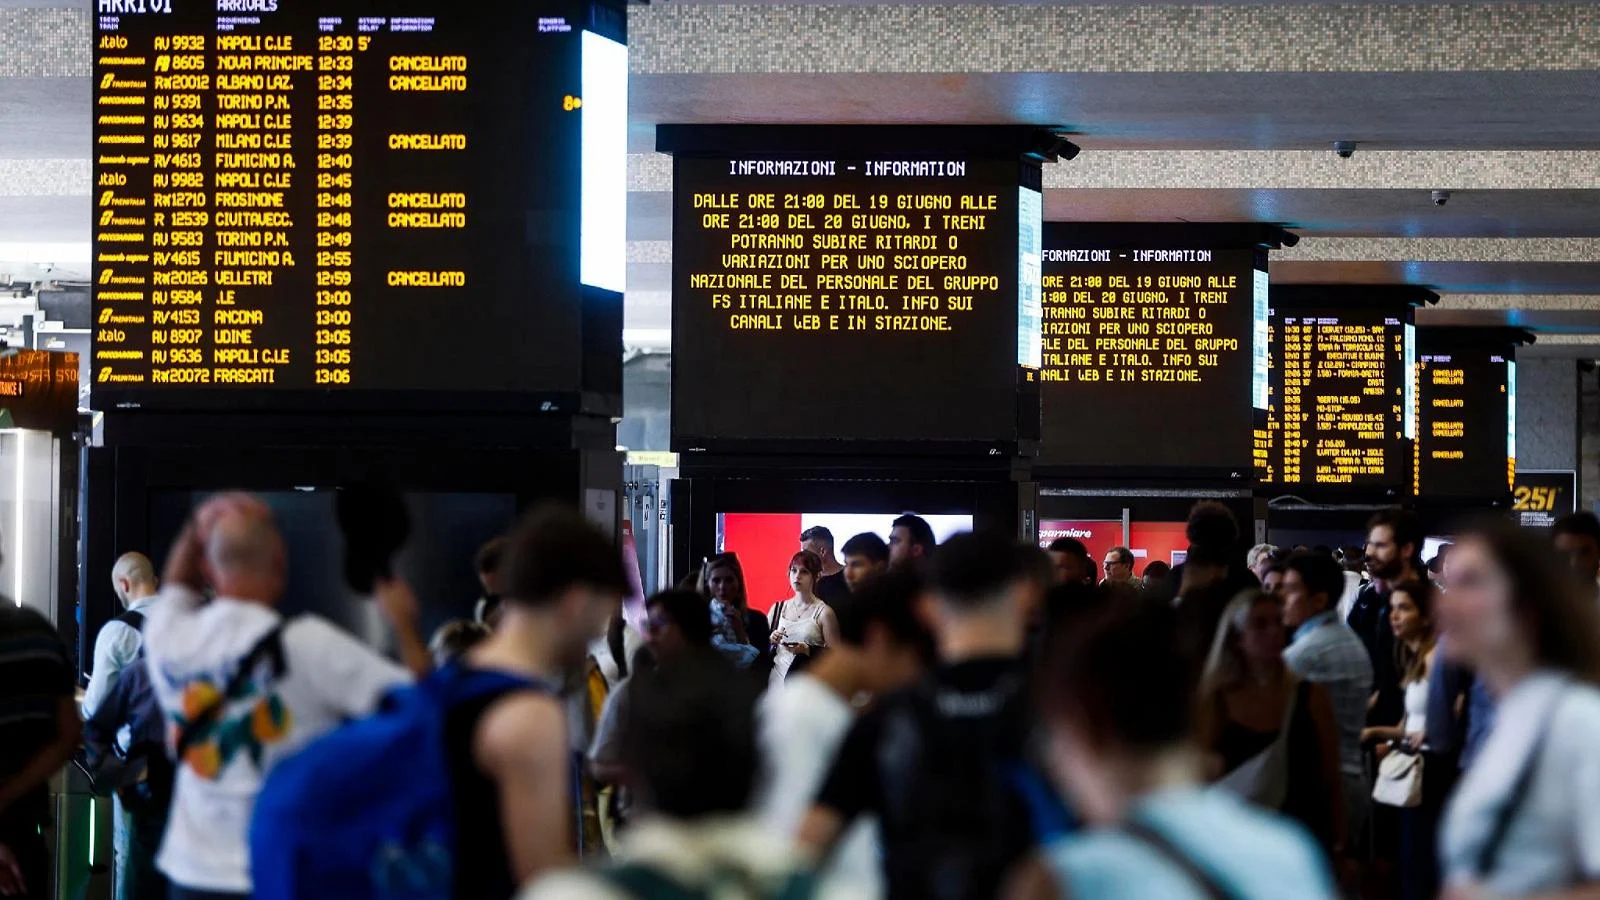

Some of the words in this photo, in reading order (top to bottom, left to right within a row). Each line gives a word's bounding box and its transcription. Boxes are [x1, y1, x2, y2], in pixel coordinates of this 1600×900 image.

[99, 0, 172, 13] ARRIVI
[217, 0, 277, 11] ARRIVALS
[154, 36, 169, 50] AV
[172, 36, 204, 50] 9932
[217, 36, 261, 50] NAPOLI
[265, 36, 292, 50] C.LE
[319, 36, 353, 51] 12:30
[172, 55, 204, 70] 8605
[254, 55, 313, 70] PRINCIPE
[318, 56, 353, 70] 12:33
[390, 56, 466, 71] CANCELLATO
[216, 75, 261, 90] ALBANO
[266, 75, 293, 90] LAZ.
[318, 75, 352, 90] 12:34
[389, 75, 466, 90] CANCELLATO
[154, 95, 169, 109] AV
[172, 94, 201, 109] 9391
[217, 94, 262, 109] TORINO
[265, 95, 290, 109] P.N.
[318, 95, 352, 109] 12:35
[154, 115, 169, 129] AV
[172, 114, 204, 128] 9634
[216, 114, 260, 129] NAPOLI
[264, 114, 291, 129] C.LE
[318, 114, 352, 129] 12:39
[154, 134, 168, 148] AV
[172, 133, 201, 148] 9617
[216, 134, 261, 148] MILANO
[264, 134, 291, 148] C.LE
[318, 134, 352, 149] 12:39
[389, 134, 465, 149] CANCELLATO
[216, 153, 280, 168] FIUMICINO
[283, 153, 295, 168] A.
[318, 154, 352, 168] 12:40
[730, 161, 835, 175] INFORMAZIONI
[866, 161, 965, 176] INFORMATION
[154, 174, 168, 187] AV
[171, 172, 203, 187] 9982
[216, 172, 260, 187] NAPOLI
[263, 173, 291, 188] C.LE
[318, 173, 352, 188] 12:45
[215, 192, 284, 207] FROSINONE
[317, 193, 351, 207] 12:48
[388, 193, 465, 207] CANCELLATO
[694, 194, 738, 208] DALLE
[749, 194, 774, 208] ORE
[785, 194, 824, 208] 21:00
[834, 194, 860, 208] DEL
[870, 195, 887, 208] 19
[898, 195, 951, 209] GIUGNO
[961, 195, 996, 209] ALLE
[154, 213, 165, 226] R
[171, 212, 208, 226] 12539
[215, 212, 293, 227] CIVITAVECC.
[317, 212, 351, 227] 12:48
[388, 212, 465, 227] CANCELLATO
[703, 214, 729, 228] ORE
[739, 214, 779, 228] 21:00
[788, 214, 815, 228] DEL
[825, 215, 842, 228] 20
[852, 215, 910, 229] GIUGNO,
[924, 215, 930, 229] I
[943, 215, 985, 229] TRENI
[153, 232, 168, 246] AV
[171, 231, 203, 246] 9583
[216, 231, 261, 246] TORINO
[264, 232, 289, 246] P.N.
[317, 232, 351, 246] 12:49
[732, 235, 803, 249] POTRANNO
[813, 235, 866, 249] SUBIRE
[876, 235, 937, 249] RITARDI
[949, 236, 957, 249] O
[723, 255, 810, 269] VARIAZIONI
[822, 255, 848, 269] PER
[858, 255, 884, 269] UNO
[894, 255, 966, 269] SCIOPERO
[1134, 250, 1211, 261] INFORMATION
[215, 270, 272, 285] VELLETRI
[316, 271, 351, 285] 12:59
[388, 271, 465, 285] CANCELLATO
[691, 274, 771, 288] NAZIONALE
[781, 275, 807, 289] DEL
[817, 275, 898, 289] PERSONALE
[908, 276, 934, 289] DEL
[944, 276, 998, 290] GRUPPO
[1043, 276, 1063, 287] ORE
[1071, 276, 1102, 287] 21:00
[1109, 276, 1130, 287] DEL
[1137, 276, 1151, 287] 19
[1158, 276, 1201, 288] GIUGNO
[1208, 276, 1236, 288] ALLE
[713, 295, 730, 308] FS
[740, 295, 812, 309] ITALIANE
[821, 295, 829, 309] E
[840, 295, 888, 309] ITALO.
[903, 296, 938, 310] INFO
[948, 296, 973, 310] SUI
[1074, 292, 1094, 303] DEL
[1102, 292, 1116, 303] 20
[1123, 292, 1168, 303] GIUGNO,
[1194, 292, 1227, 303] TRENI
[215, 310, 263, 324] ANCONA
[316, 310, 351, 324] 13:00
[1093, 307, 1135, 319] SUBIRE
[1142, 307, 1189, 319] RITARDI
[731, 315, 782, 329] CANALI
[794, 315, 820, 329] WEB
[830, 315, 838, 329] E
[848, 315, 865, 329] IN
[876, 316, 951, 330] STAZIONE.
[1100, 323, 1120, 334] PER
[1128, 323, 1149, 334] UNO
[1156, 323, 1212, 334] SCIOPERO
[152, 330, 167, 344] AV
[170, 329, 202, 343] 8907
[215, 329, 252, 344] UDINE
[316, 329, 350, 344] 13:05
[1068, 338, 1088, 350] DEL
[1096, 338, 1159, 350] PERSONALE
[1167, 339, 1188, 350] DEL
[1195, 339, 1237, 350] GRUPPO
[152, 350, 167, 363] AV
[170, 349, 202, 363] 9636
[214, 349, 258, 363] NAPOLI
[262, 349, 289, 363] C.LE
[316, 349, 350, 363] 13:05
[1113, 354, 1152, 365] ITALO.
[1163, 354, 1191, 365] INFO
[1199, 354, 1217, 366] SUI
[214, 368, 274, 383] FRASCATI
[316, 369, 350, 383] 13:06
[1078, 369, 1099, 381] WEB
[1121, 370, 1134, 381] IN
[1141, 370, 1201, 381] STAZIONE.
[1316, 474, 1352, 482] CANCELLATO
